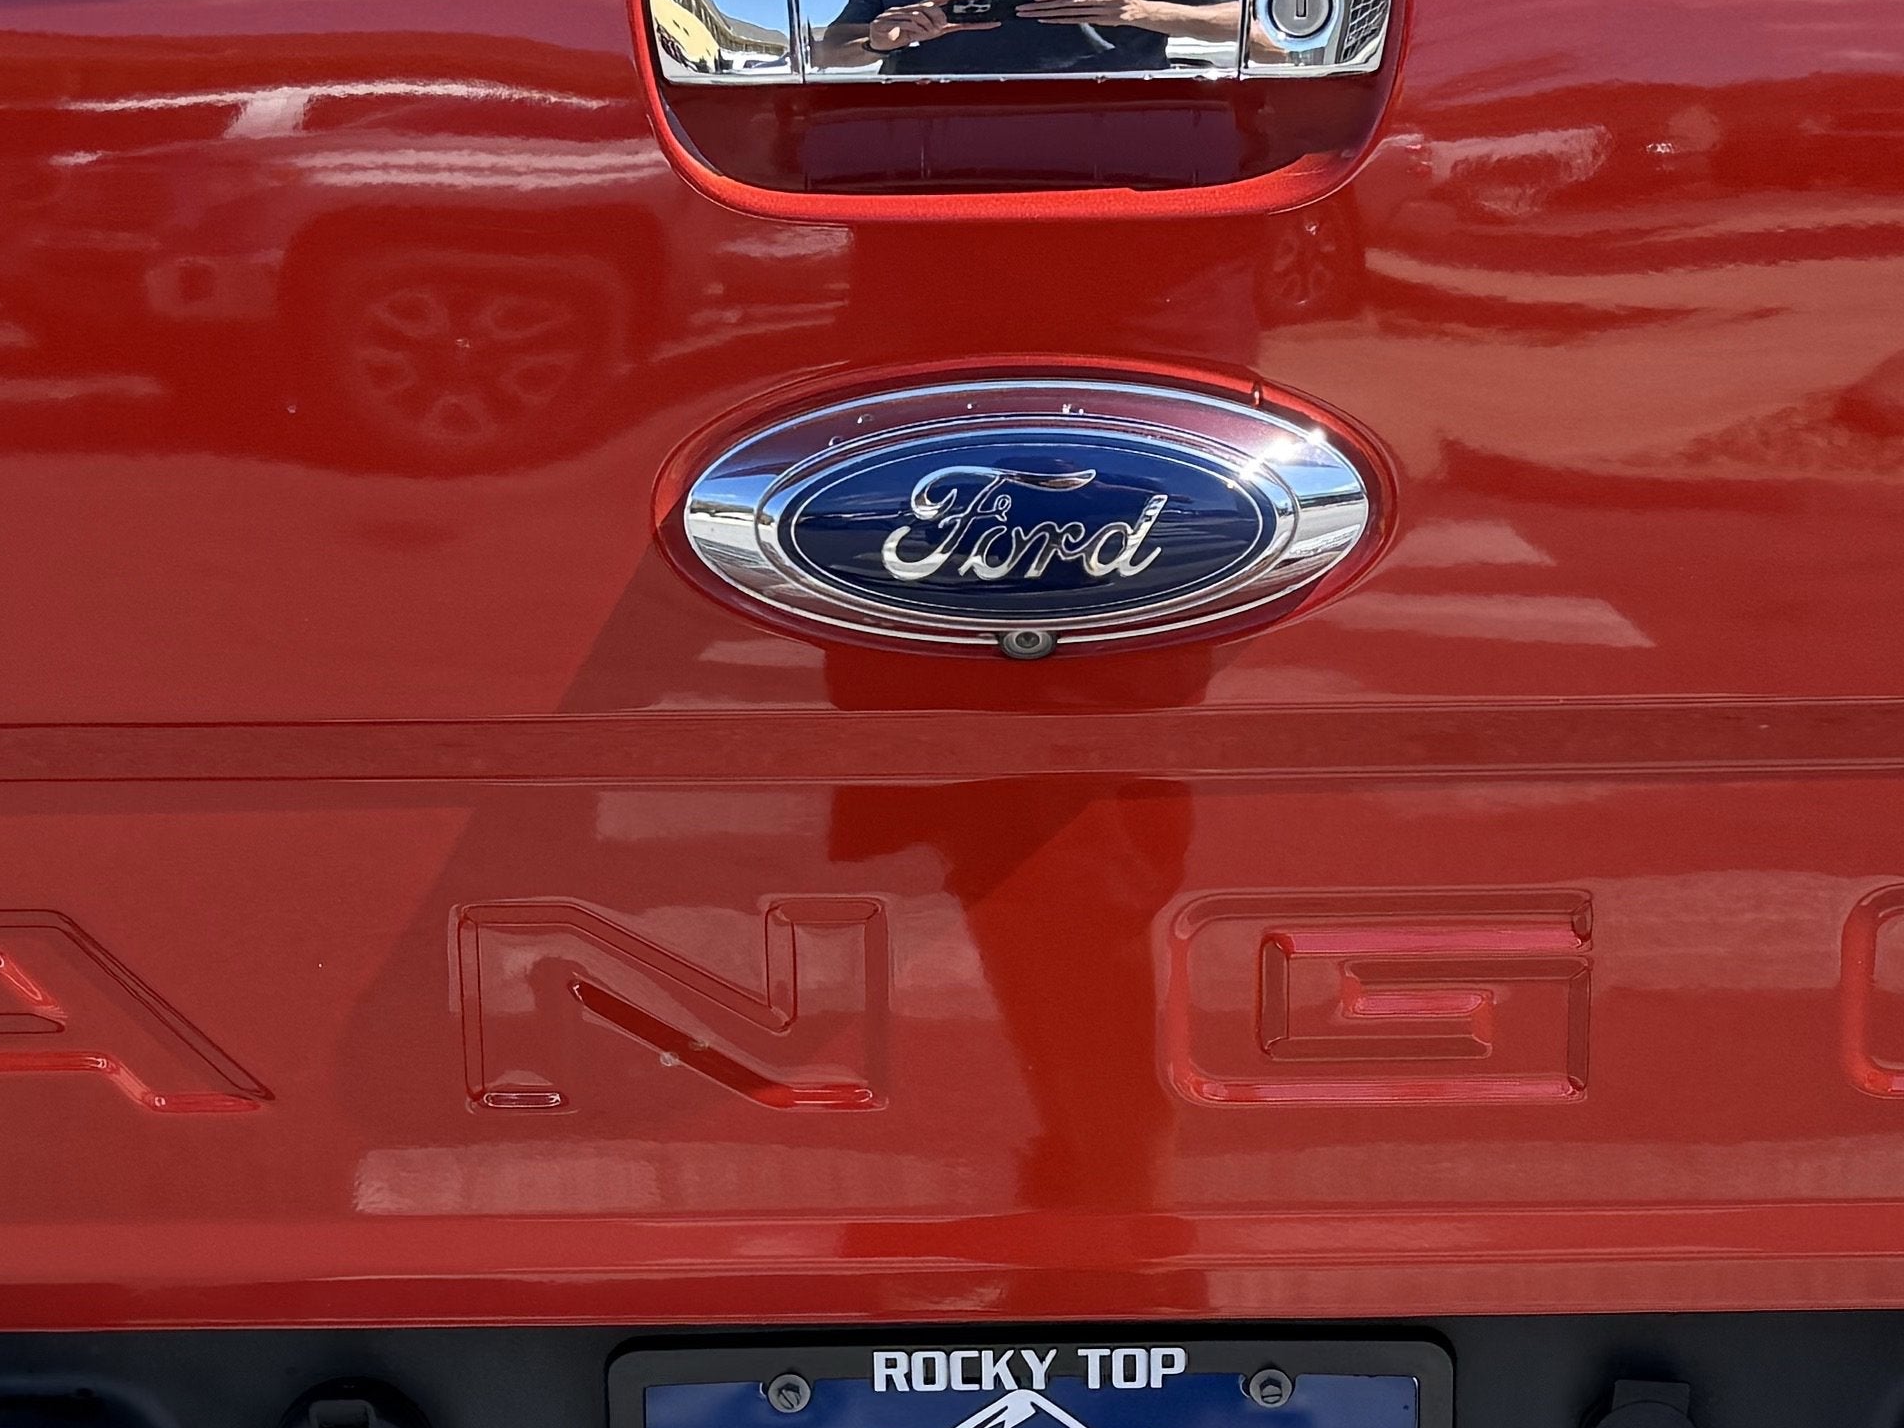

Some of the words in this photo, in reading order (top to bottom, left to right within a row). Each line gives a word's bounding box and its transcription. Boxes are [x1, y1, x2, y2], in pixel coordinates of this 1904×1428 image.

[881, 465, 1166, 582] Ford
[872, 1347, 1058, 1392] ROCKY
[1077, 1347, 1188, 1390] TOP
